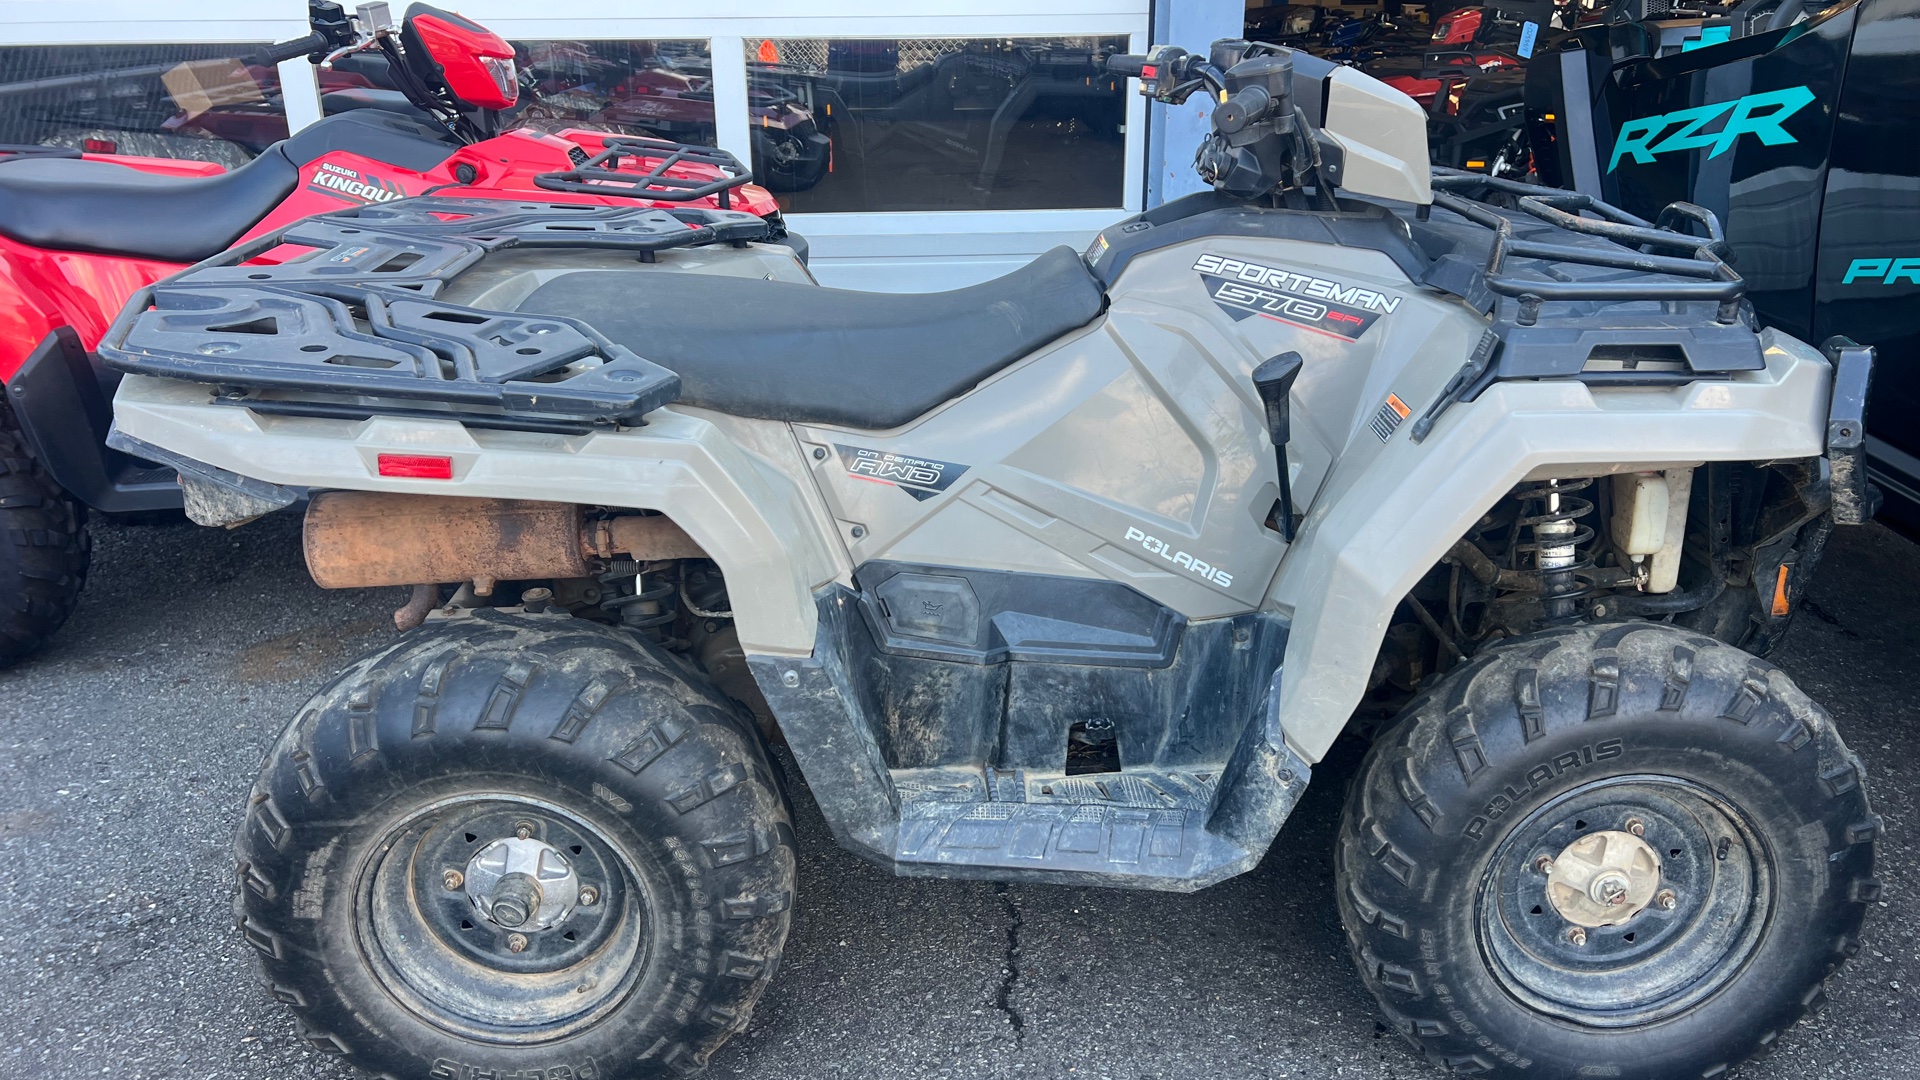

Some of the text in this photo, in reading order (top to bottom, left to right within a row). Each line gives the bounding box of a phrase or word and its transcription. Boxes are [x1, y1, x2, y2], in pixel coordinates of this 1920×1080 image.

[1606, 85, 1817, 176] RZR
[322, 162, 357, 178] SUZUKI
[1193, 253, 1403, 315] SPORTSMAN
[1214, 281, 1327, 322] 570
[849, 457, 941, 485] AWD
[857, 449, 945, 471] ON DEMAND
[1124, 526, 1234, 588] POLARIS
[1463, 738, 1623, 841] POLARIS
